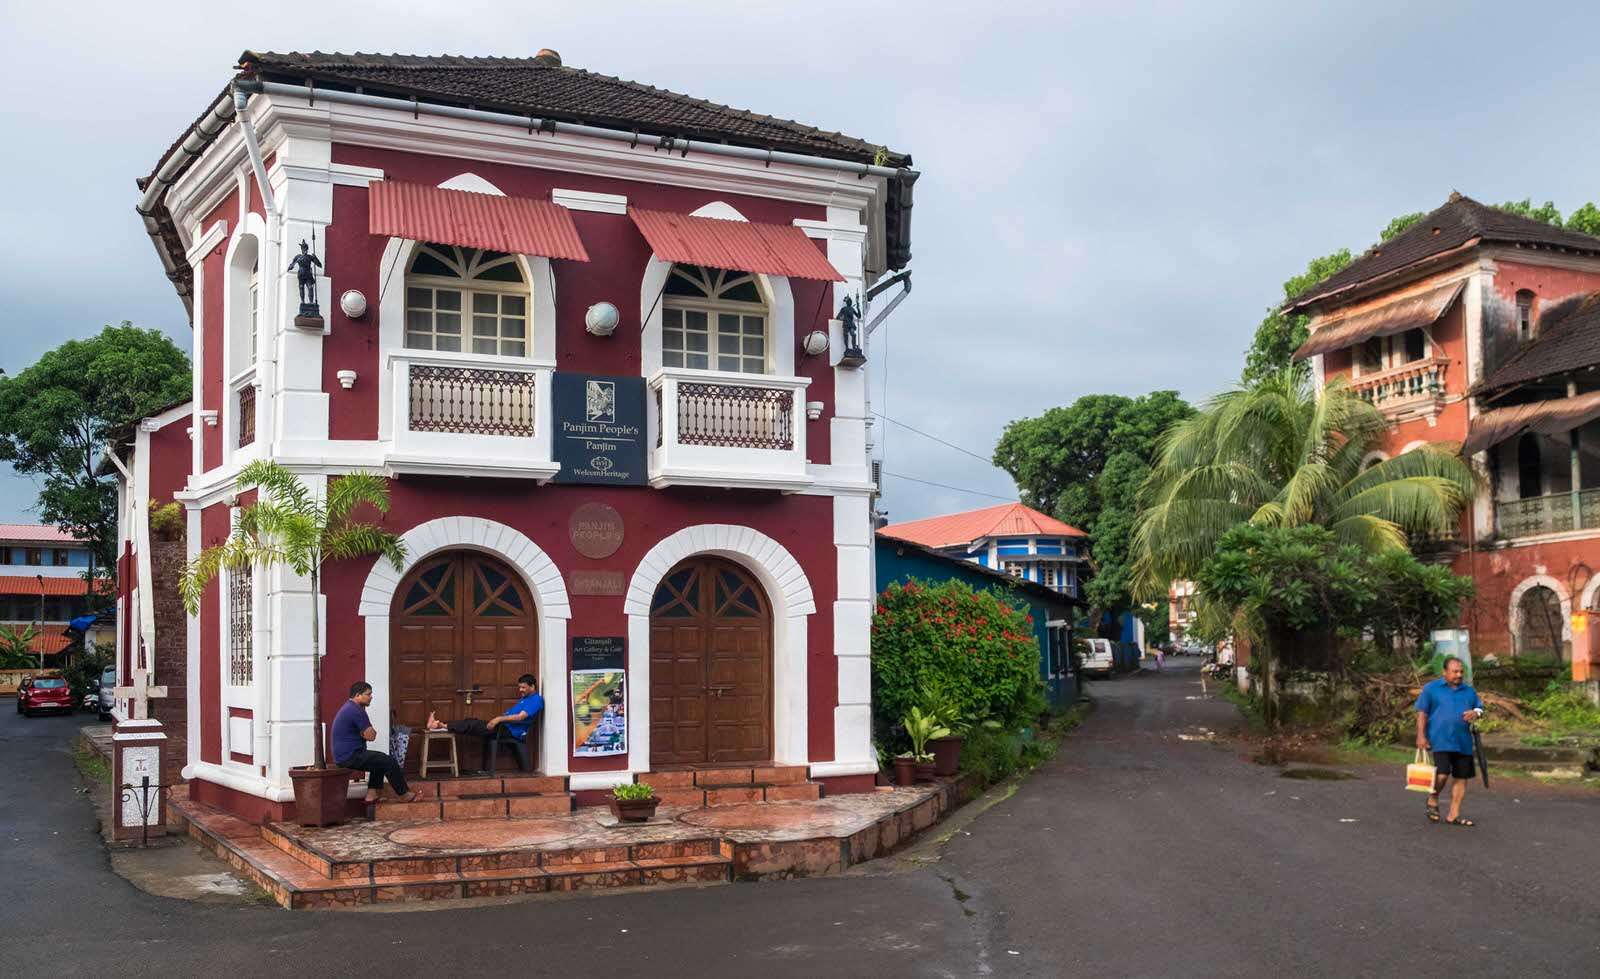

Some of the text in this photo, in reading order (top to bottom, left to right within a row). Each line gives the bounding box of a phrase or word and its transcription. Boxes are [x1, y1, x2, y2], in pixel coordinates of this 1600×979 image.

[563, 422, 639, 436] Panjim People's
[586, 441, 616, 452] Panjim
[574, 468, 629, 479] WelcomHeritage
[584, 646, 602, 654] Gallery
